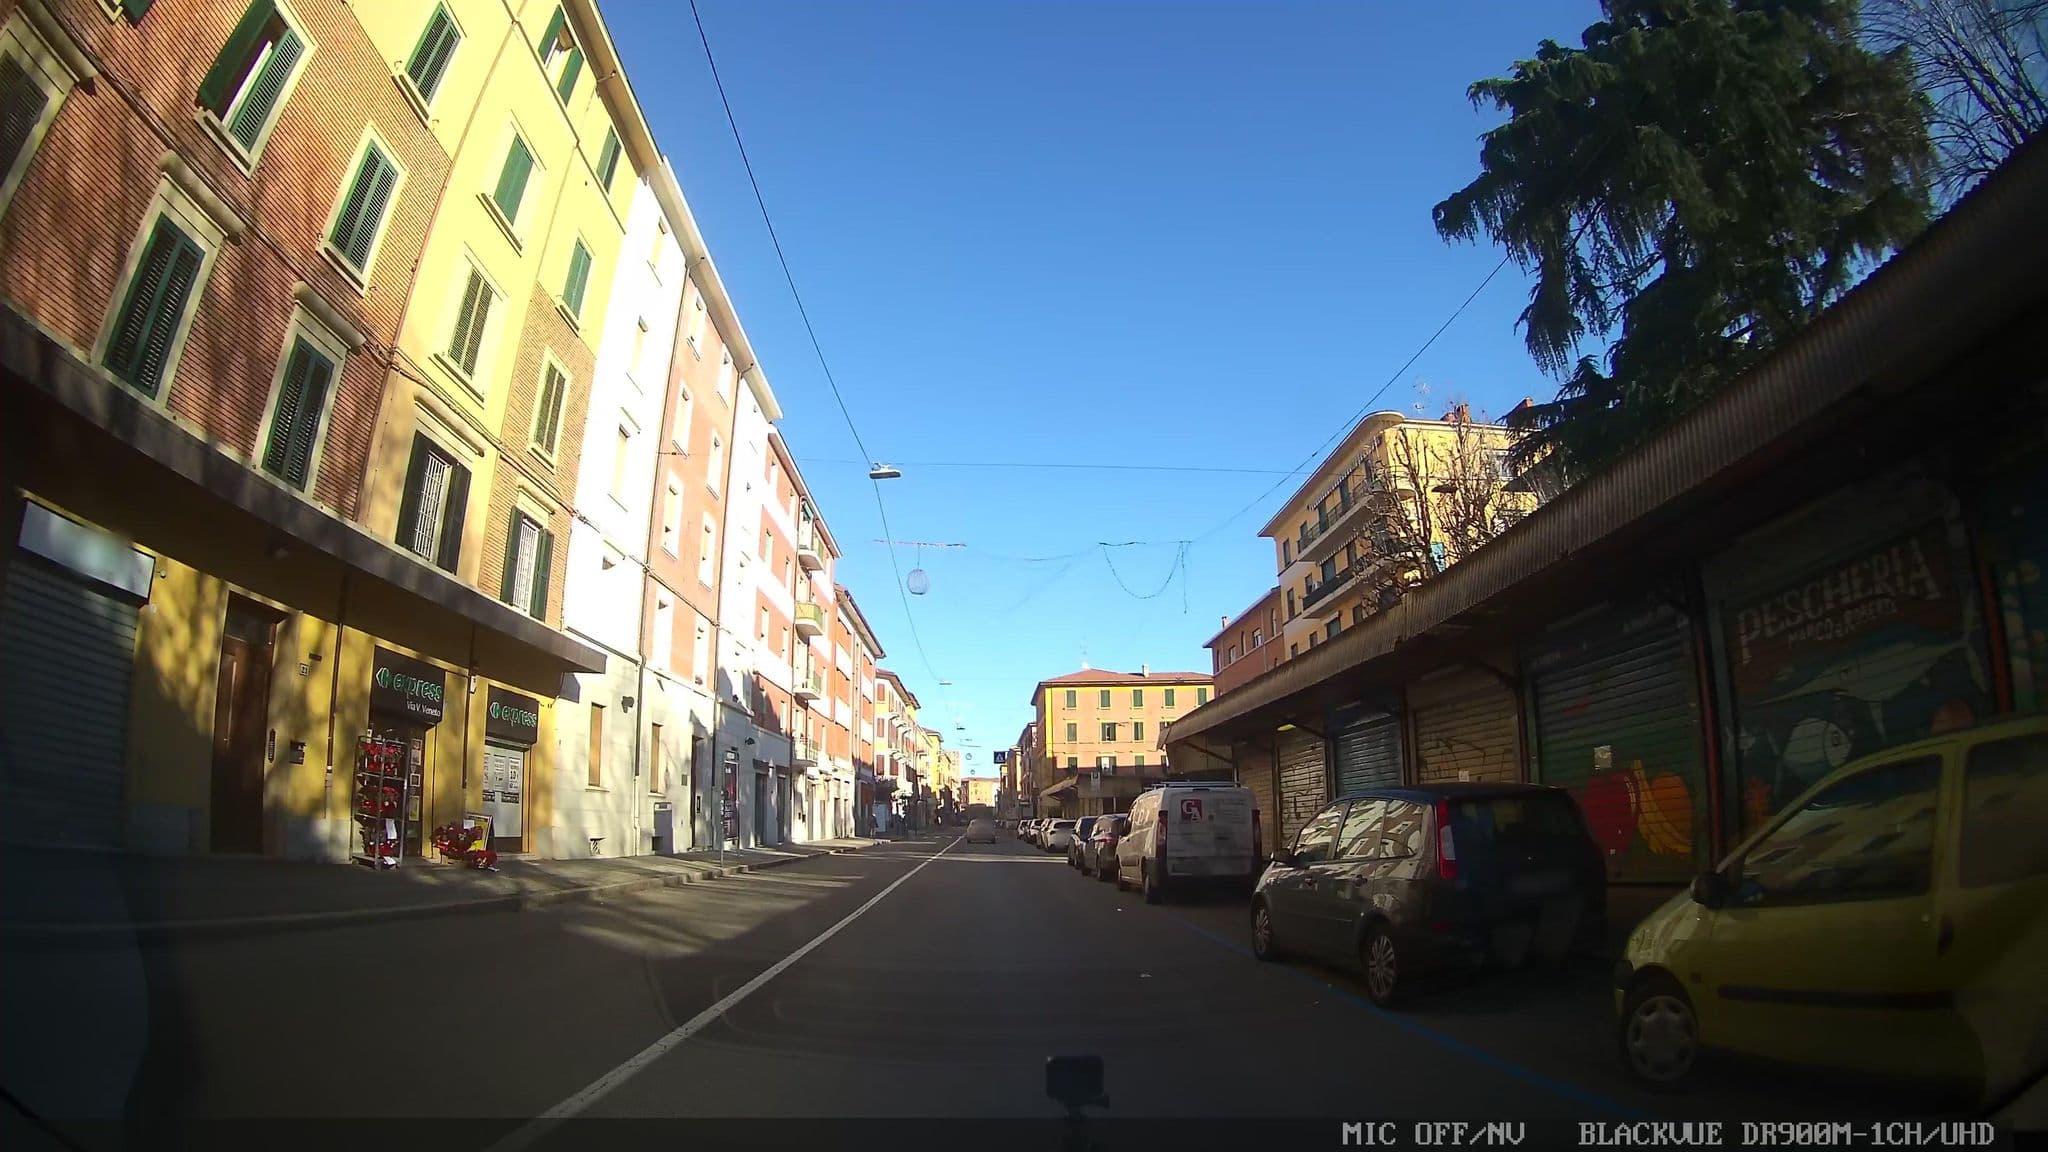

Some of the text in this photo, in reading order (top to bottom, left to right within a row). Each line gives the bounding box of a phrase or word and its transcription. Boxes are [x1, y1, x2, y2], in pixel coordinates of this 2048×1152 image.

[1737, 537, 1940, 665] PESCHERIA
[394, 673, 442, 703] express
[407, 700, 416, 712] Via
[422, 704, 441, 717] Veneto
[502, 706, 537, 728] express
